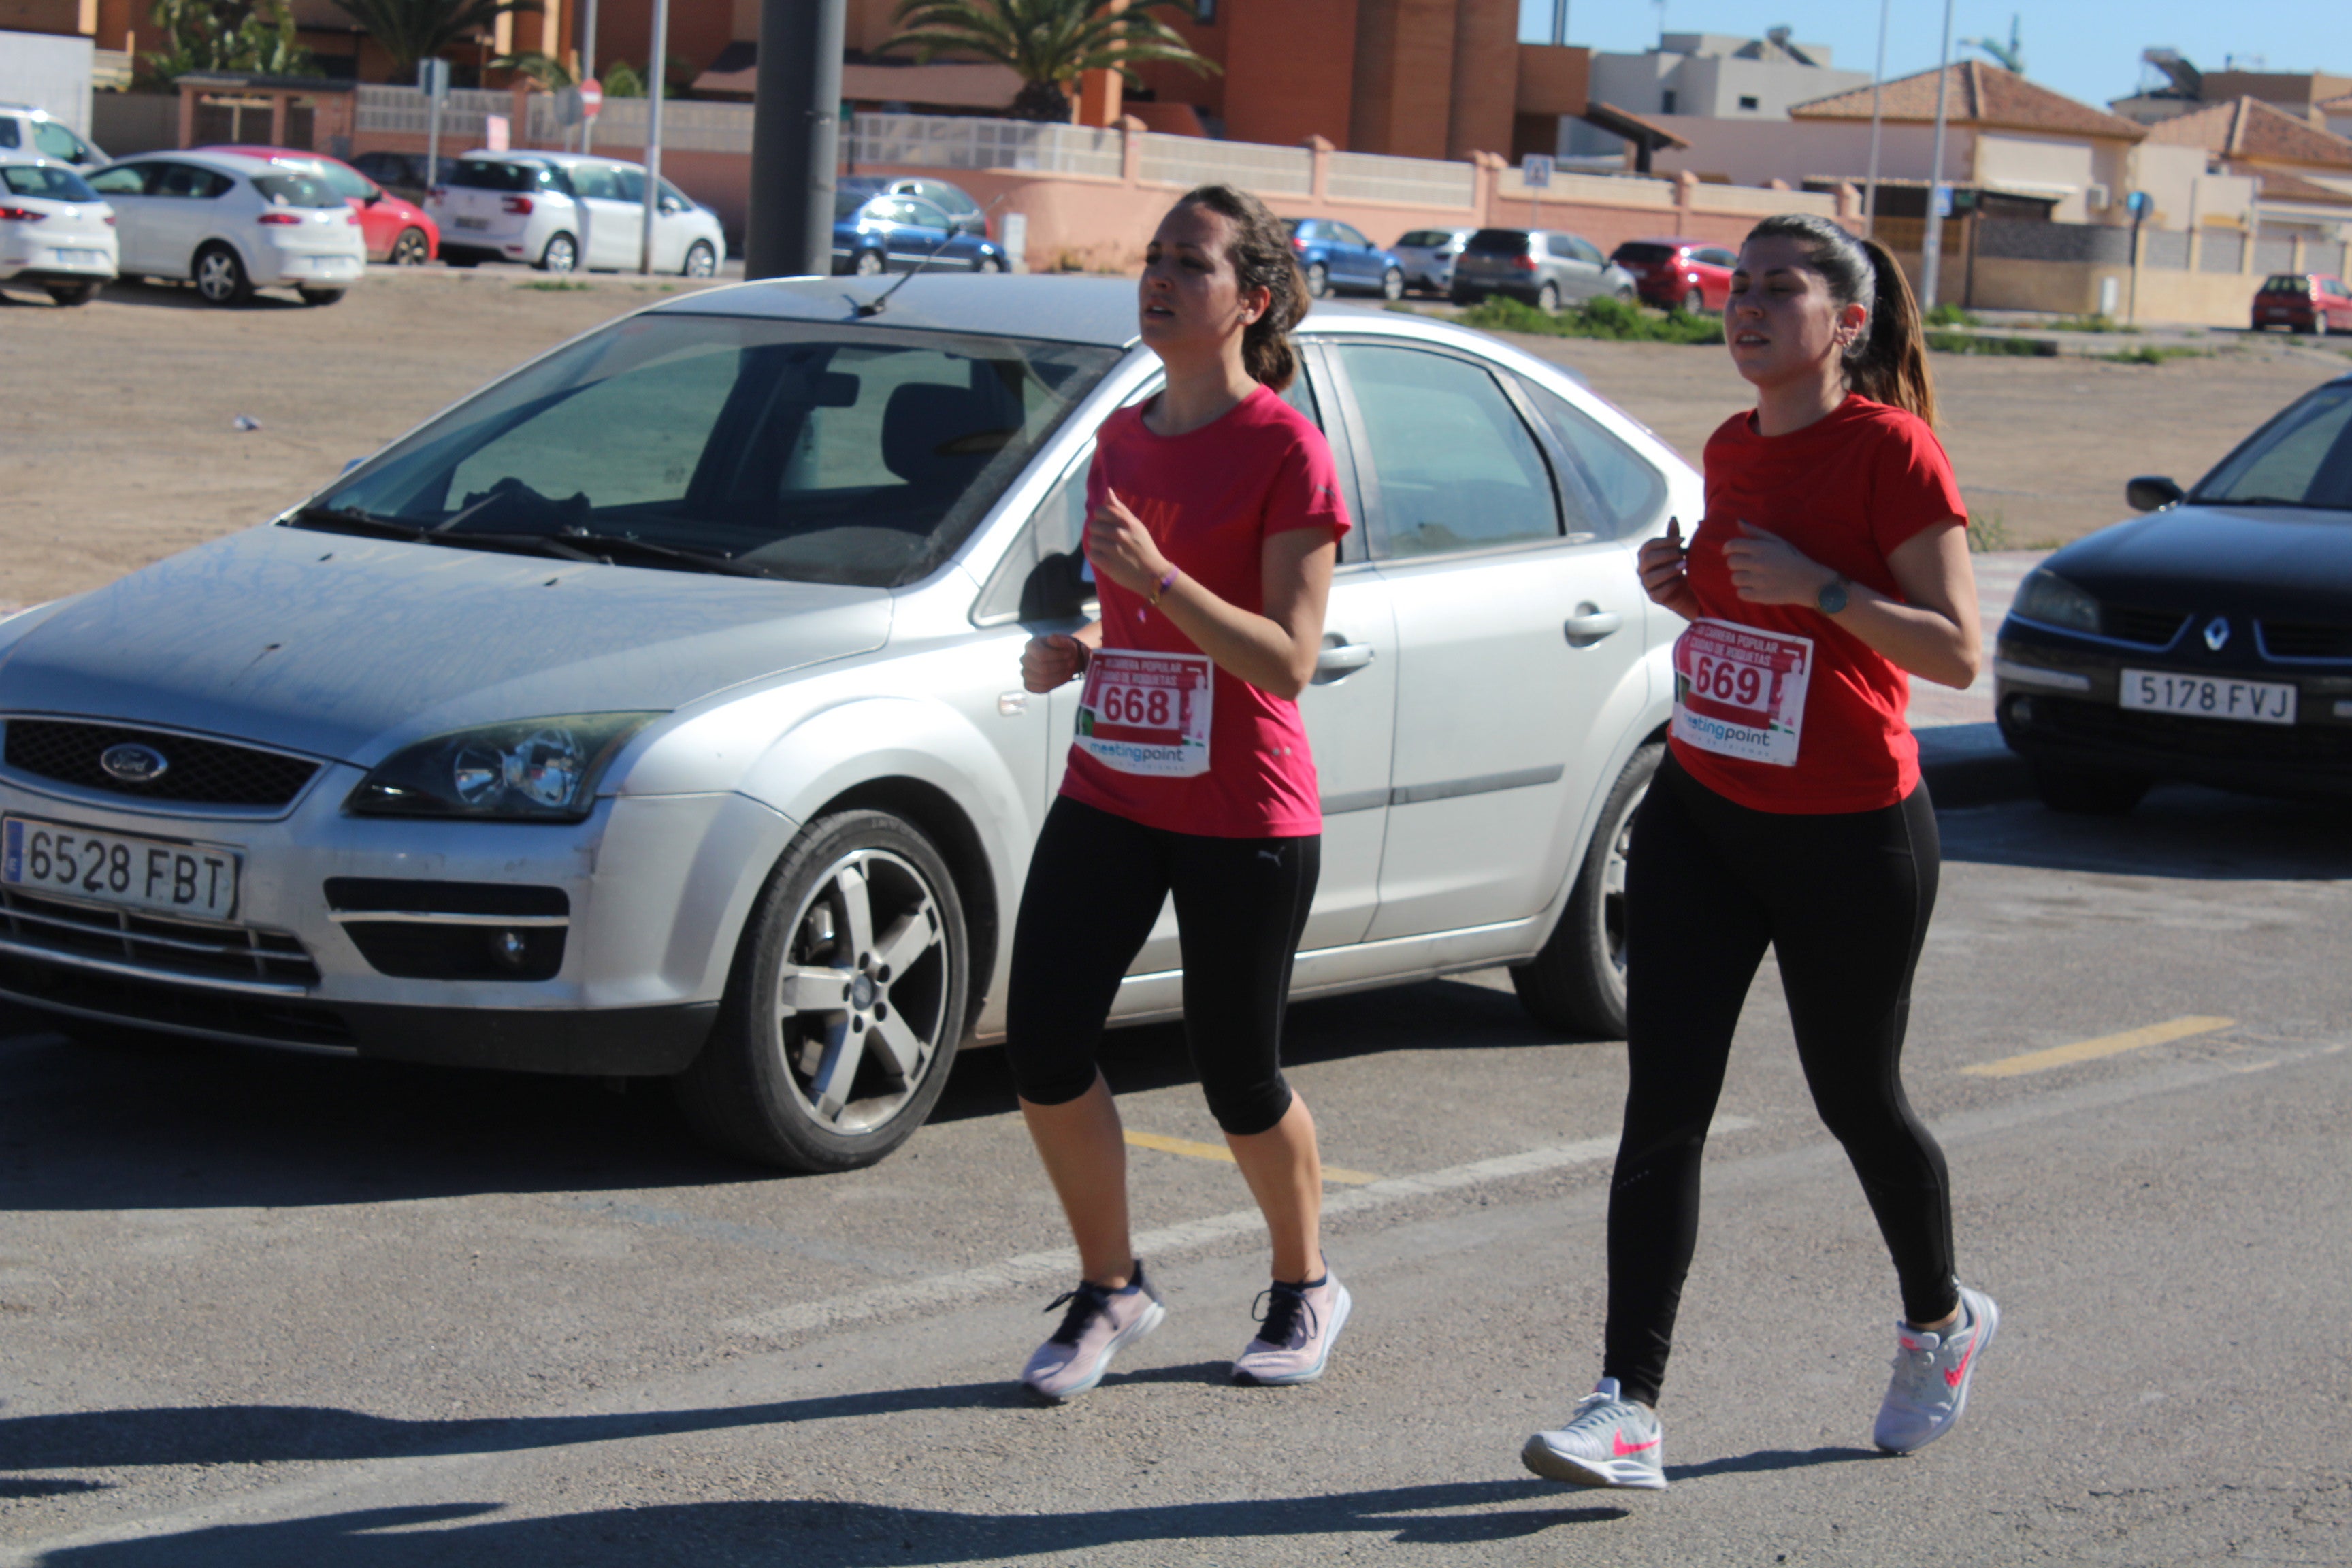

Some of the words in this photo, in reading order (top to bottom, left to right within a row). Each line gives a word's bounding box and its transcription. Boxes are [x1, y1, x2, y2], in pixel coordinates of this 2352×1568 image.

[1737, 634, 1778, 653] POPULAR
[1141, 661, 1182, 674] POPULAR
[1697, 656, 1761, 705] 669
[1104, 686, 1169, 725] 668
[2142, 676, 2216, 711] 5178
[2228, 685, 2288, 719] FVJ
[1090, 742, 1185, 762] meetingpoint
[30, 830, 131, 893] 6528
[146, 848, 224, 909] FBT
